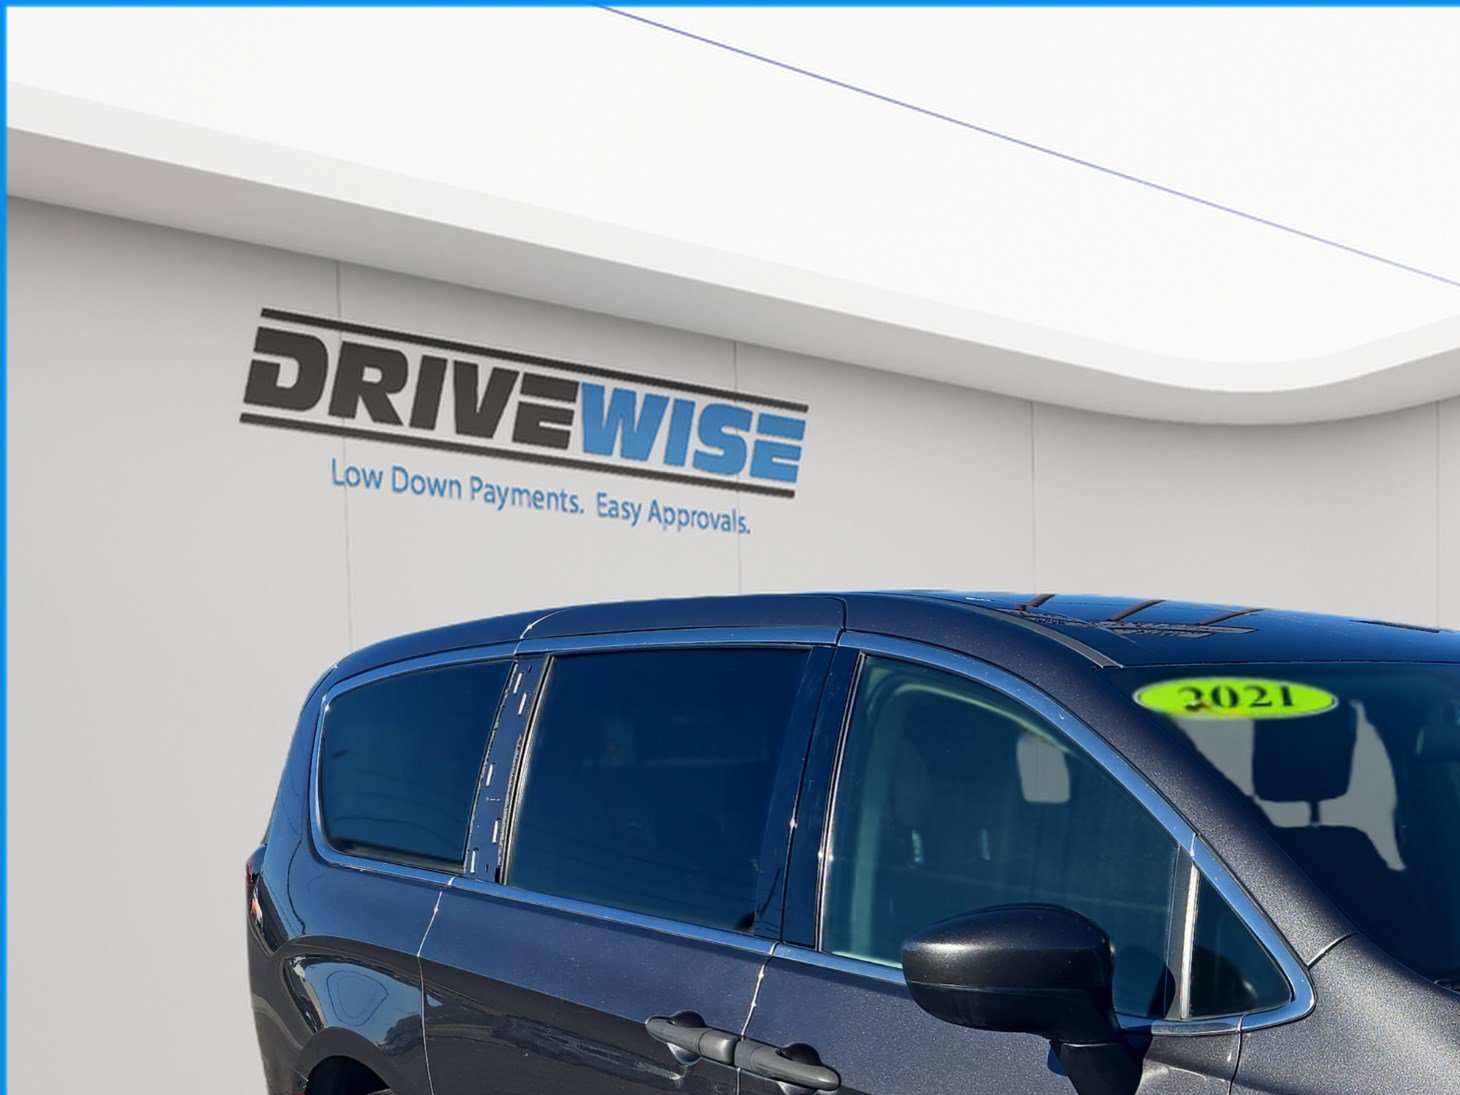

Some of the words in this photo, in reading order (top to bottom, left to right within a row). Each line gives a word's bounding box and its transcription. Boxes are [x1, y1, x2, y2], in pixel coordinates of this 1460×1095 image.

[243, 326, 806, 483] DRIVEWISE
[331, 458, 383, 490] Low
[391, 464, 462, 500] Down
[470, 476, 585, 515] Payments.
[596, 492, 642, 527] Easy
[648, 497, 752, 535] Approvals.
[1177, 684, 1296, 712] 2021
